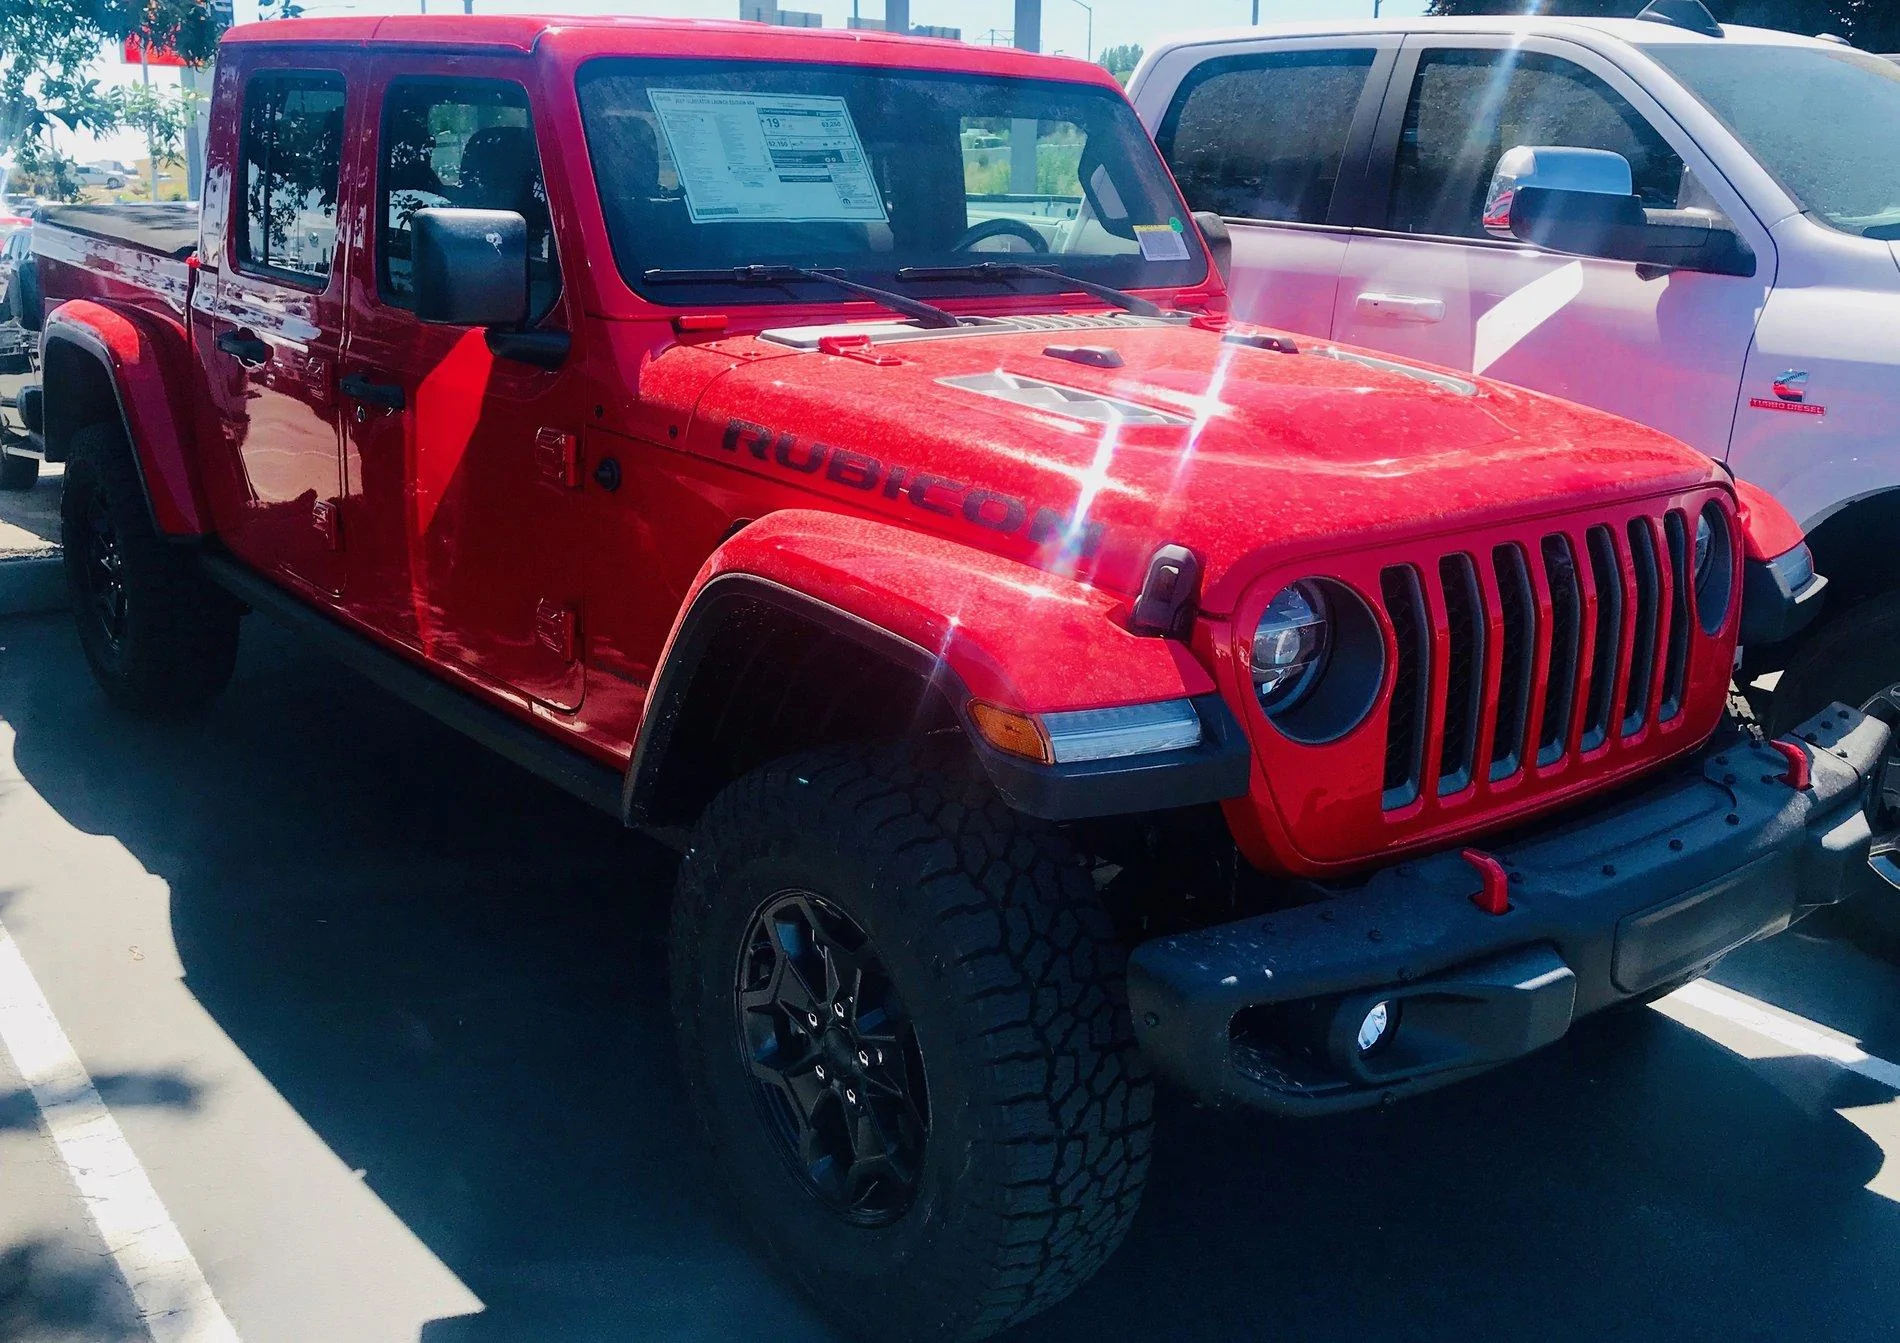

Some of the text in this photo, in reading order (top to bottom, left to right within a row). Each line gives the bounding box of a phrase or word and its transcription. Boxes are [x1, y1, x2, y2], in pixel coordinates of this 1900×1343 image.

[766, 117, 780, 128] 19
[1753, 399, 1823, 414] TURBO DIESEL
[722, 418, 1103, 556] RUBICON
